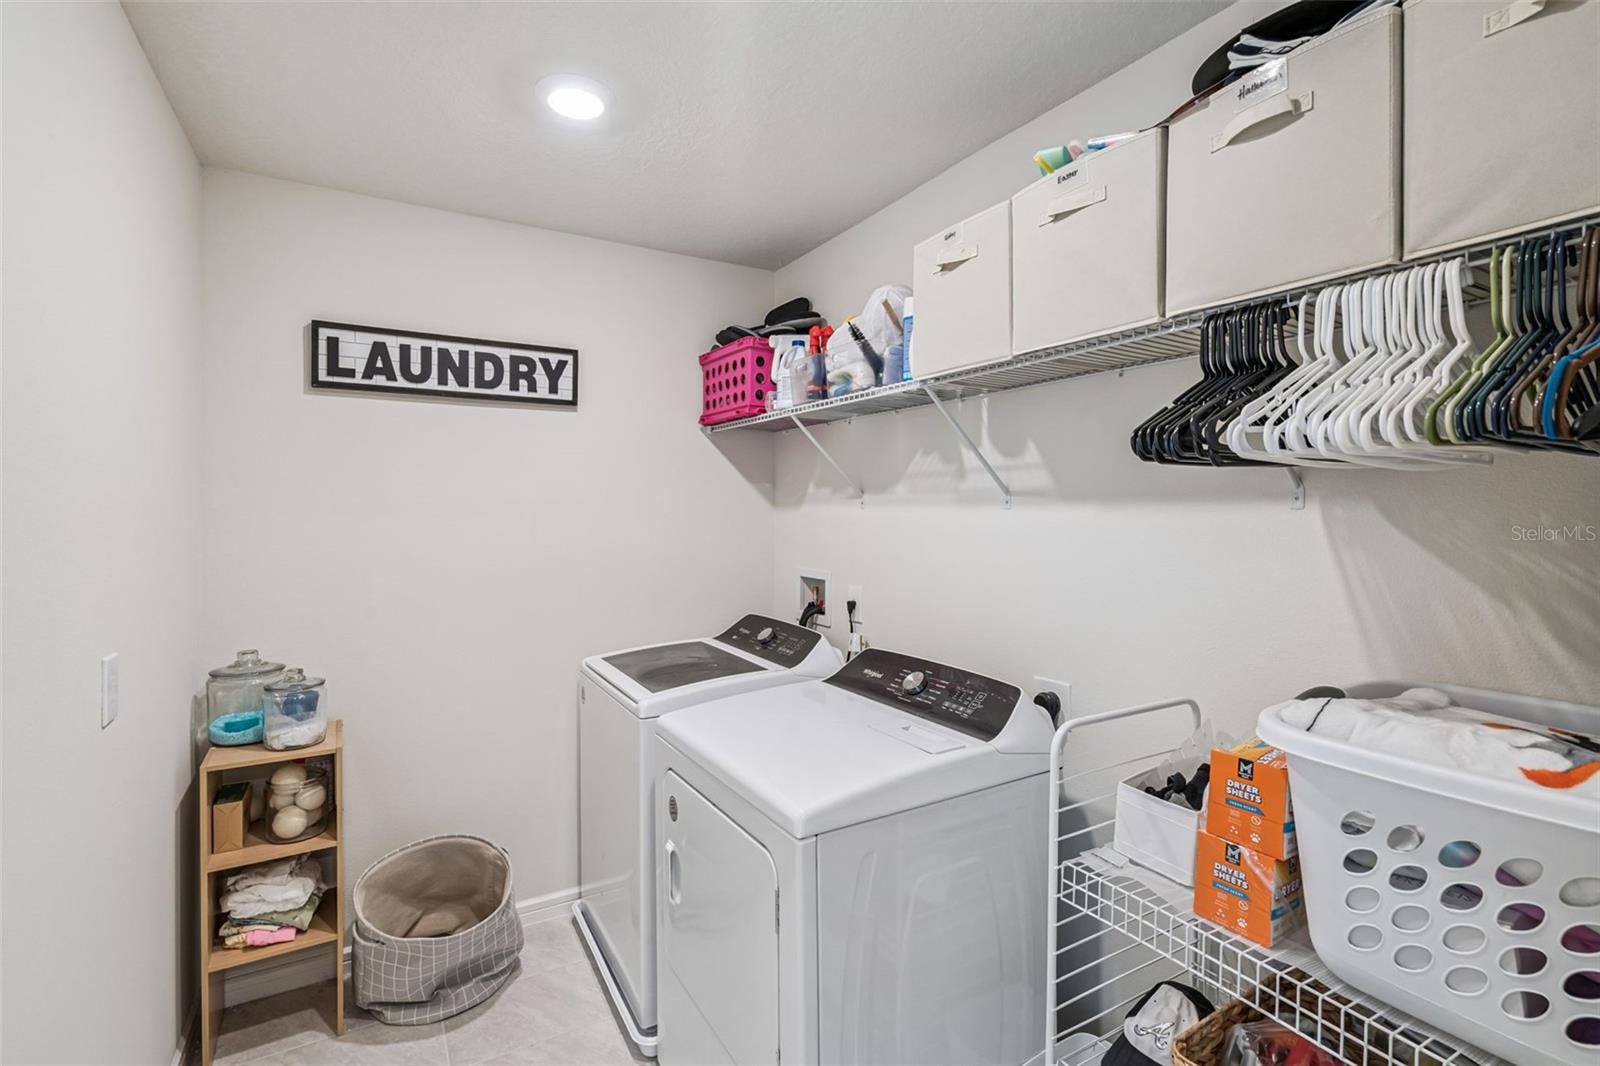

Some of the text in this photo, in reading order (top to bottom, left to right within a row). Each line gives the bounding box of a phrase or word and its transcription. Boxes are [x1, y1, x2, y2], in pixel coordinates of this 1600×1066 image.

[326, 336, 569, 395] LAUNDRY
[1226, 779, 1260, 795] DRYER
[1226, 787, 1262, 804] SHEETS
[1213, 869, 1249, 890] SHEETS
[1214, 862, 1247, 880] DRYER
